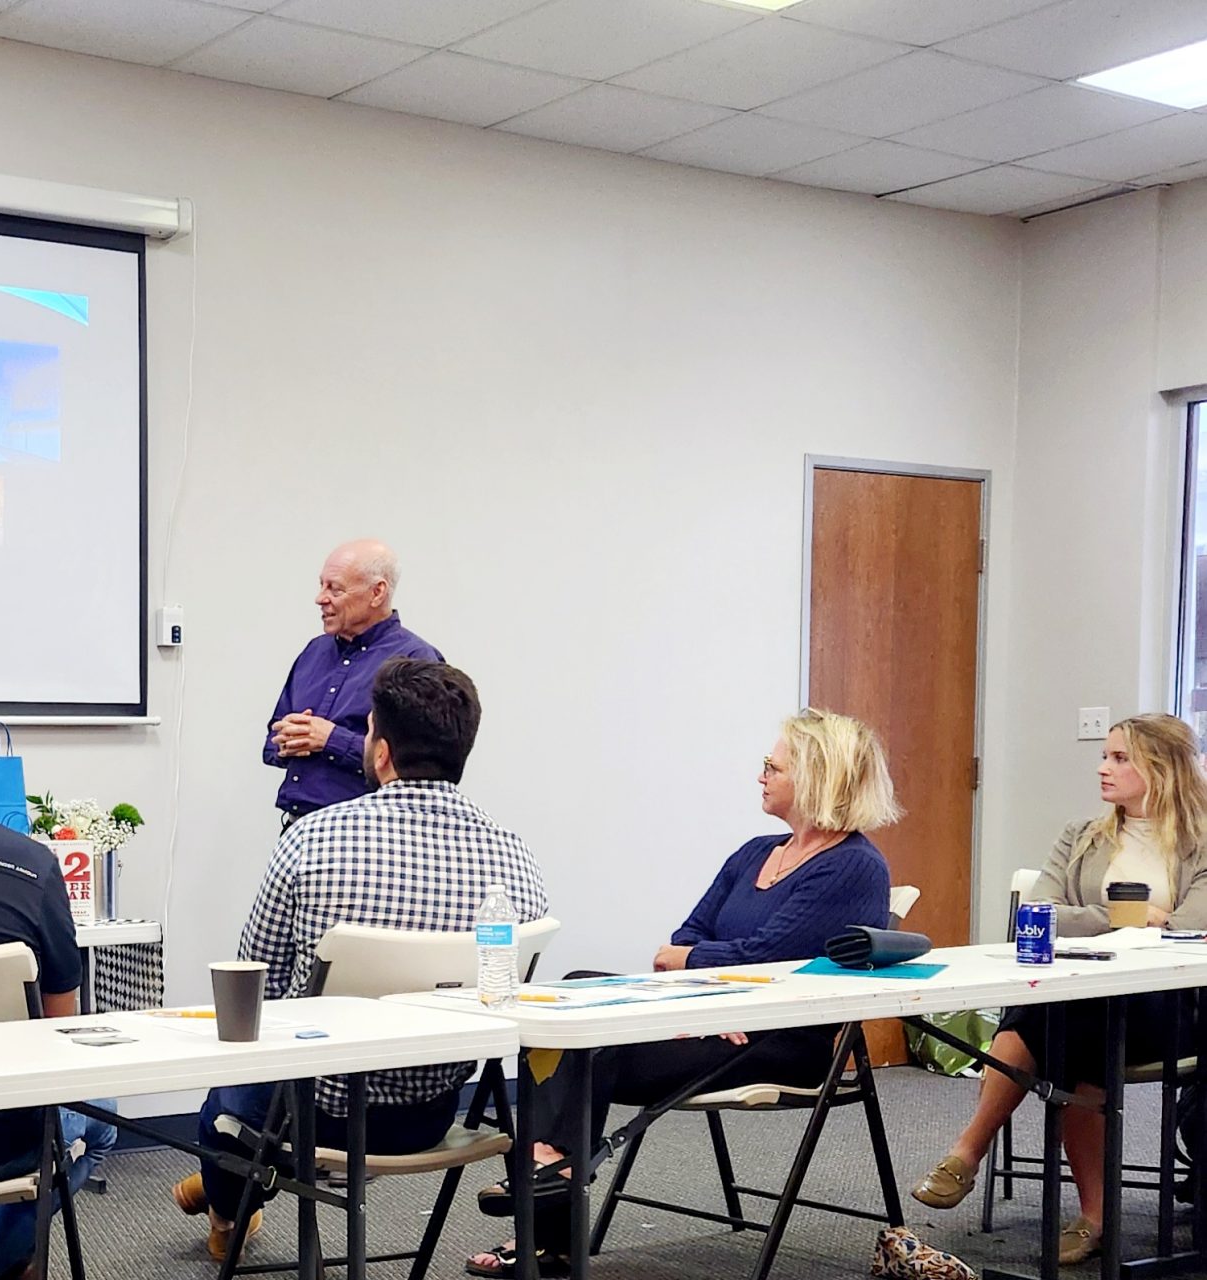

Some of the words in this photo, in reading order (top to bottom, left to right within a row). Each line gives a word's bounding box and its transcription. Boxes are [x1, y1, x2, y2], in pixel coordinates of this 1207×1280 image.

[63, 851, 91, 882] 2
[69, 882, 91, 891] EK
[69, 891, 91, 900] AR
